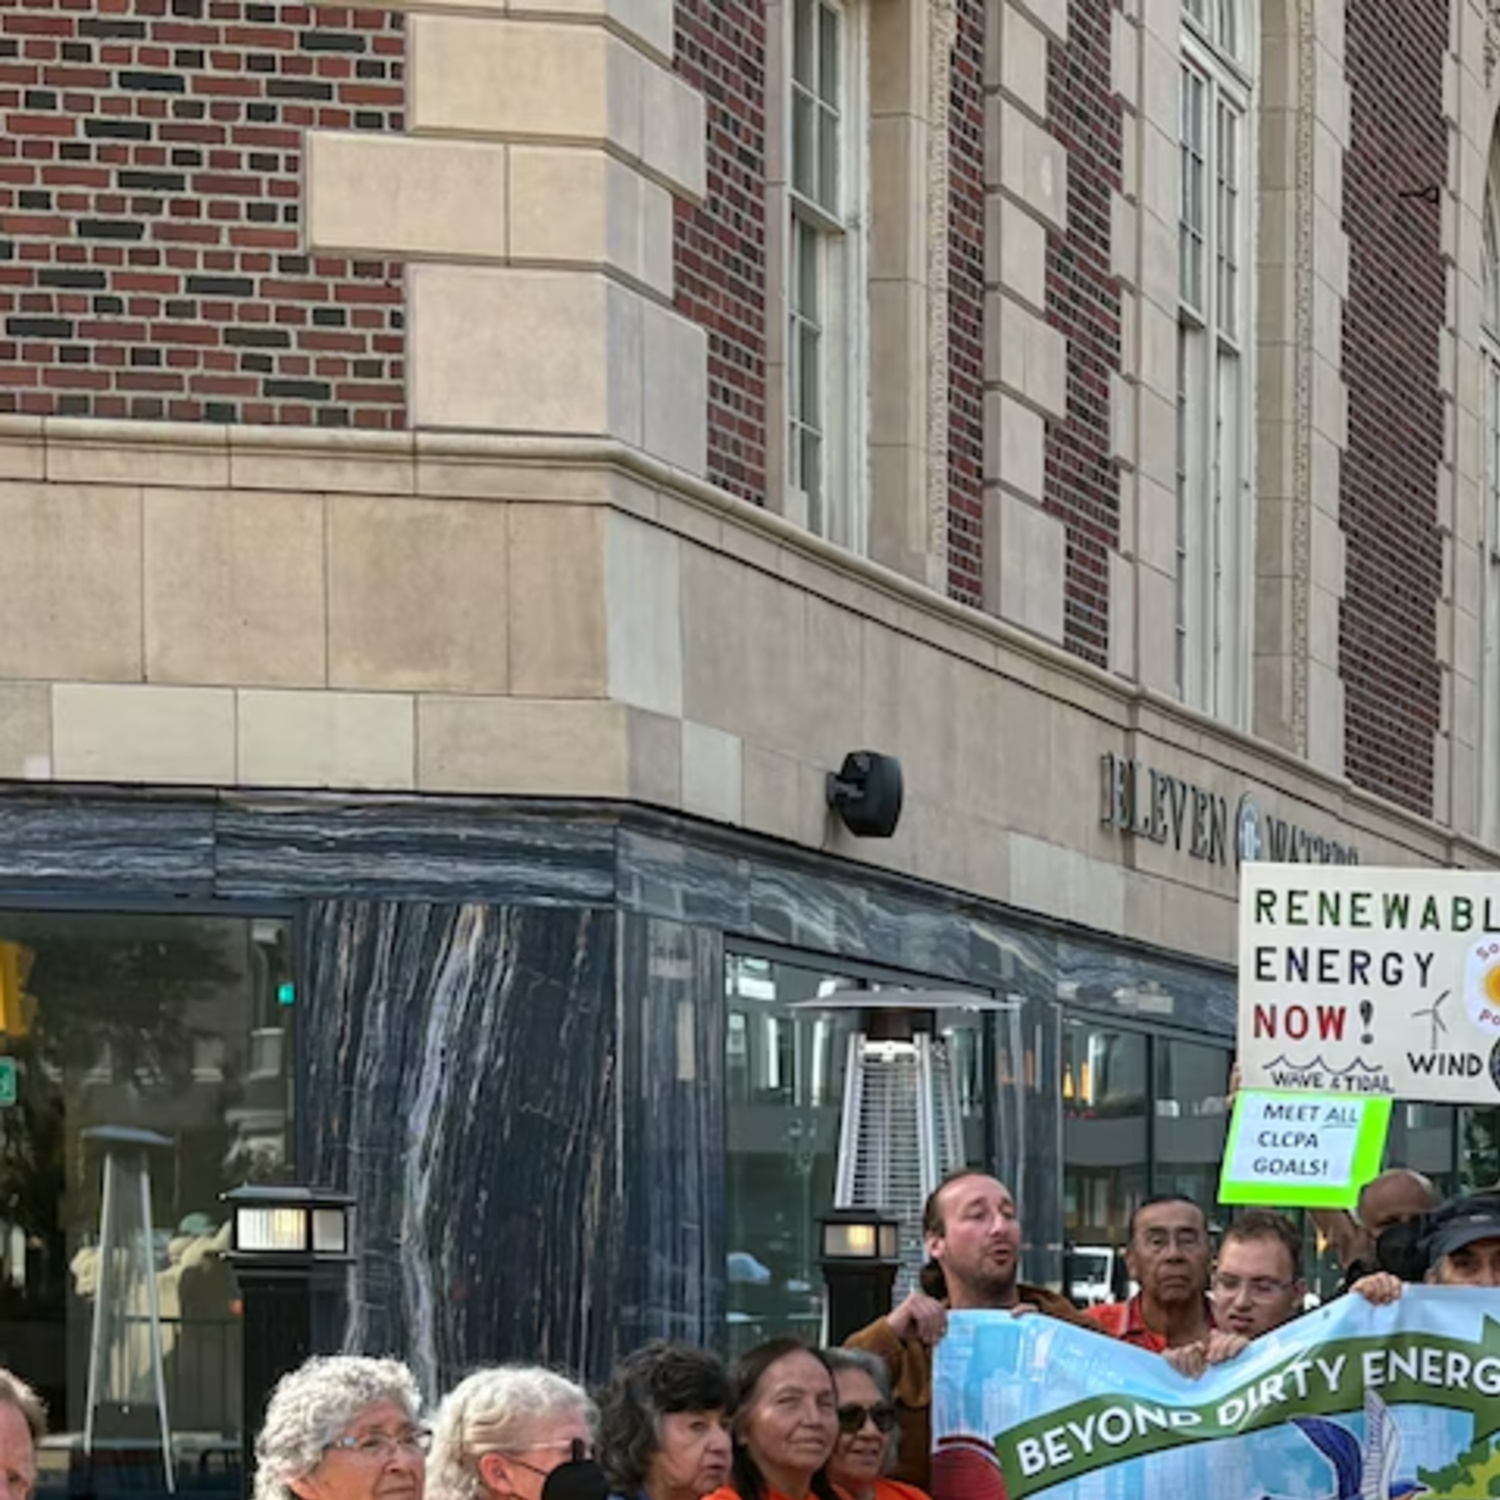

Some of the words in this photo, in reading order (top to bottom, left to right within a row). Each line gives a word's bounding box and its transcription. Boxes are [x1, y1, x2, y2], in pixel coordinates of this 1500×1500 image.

[1100, 751, 1228, 868] ELEVEN
[1253, 945, 1436, 988] ENERGY
[1252, 999, 1375, 1045] NOW!
[1406, 1051, 1484, 1078] WIND
[1271, 1069, 1326, 1090] WAVE
[1342, 1072, 1396, 1094] TIDAL
[1262, 1104, 1322, 1123] MEET
[1324, 1106, 1358, 1125] ALL
[1257, 1131, 1319, 1149] CLCPA
[1252, 1159, 1329, 1177] GOALS!
[1015, 1402, 1203, 1477] BEYOND
[1216, 1353, 1347, 1428] DIRTY
